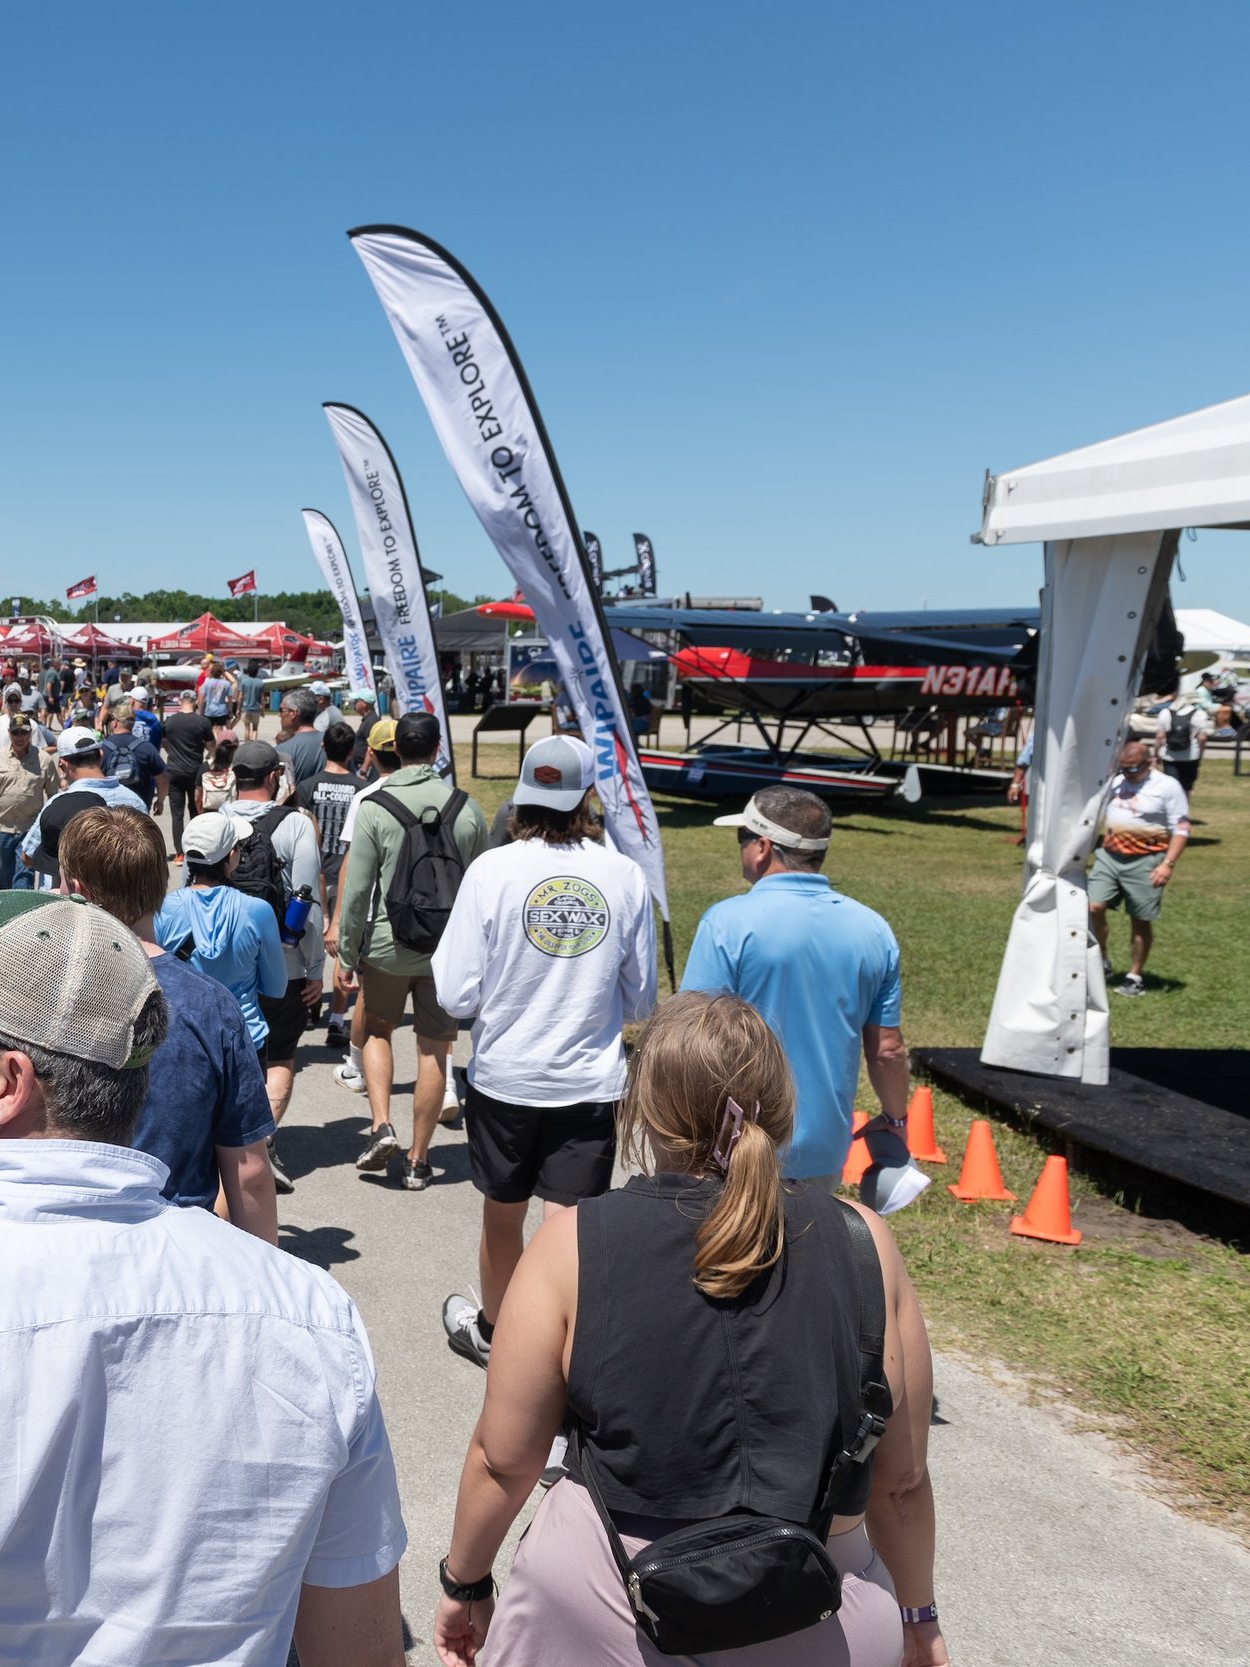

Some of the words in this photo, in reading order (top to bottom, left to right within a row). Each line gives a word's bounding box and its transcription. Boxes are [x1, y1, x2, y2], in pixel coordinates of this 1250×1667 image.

[491, 446, 522, 484] TO
[383, 536, 397, 556] TO
[389, 559, 411, 625] FREEDOM
[313, 791, 354, 802] ALL-COUNT
[318, 783, 356, 795] BROWARD
[538, 885, 558, 900] MR
[563, 882, 596, 902] ZOGS
[530, 911, 562, 922] SEX
[564, 911, 601, 926] WAX
